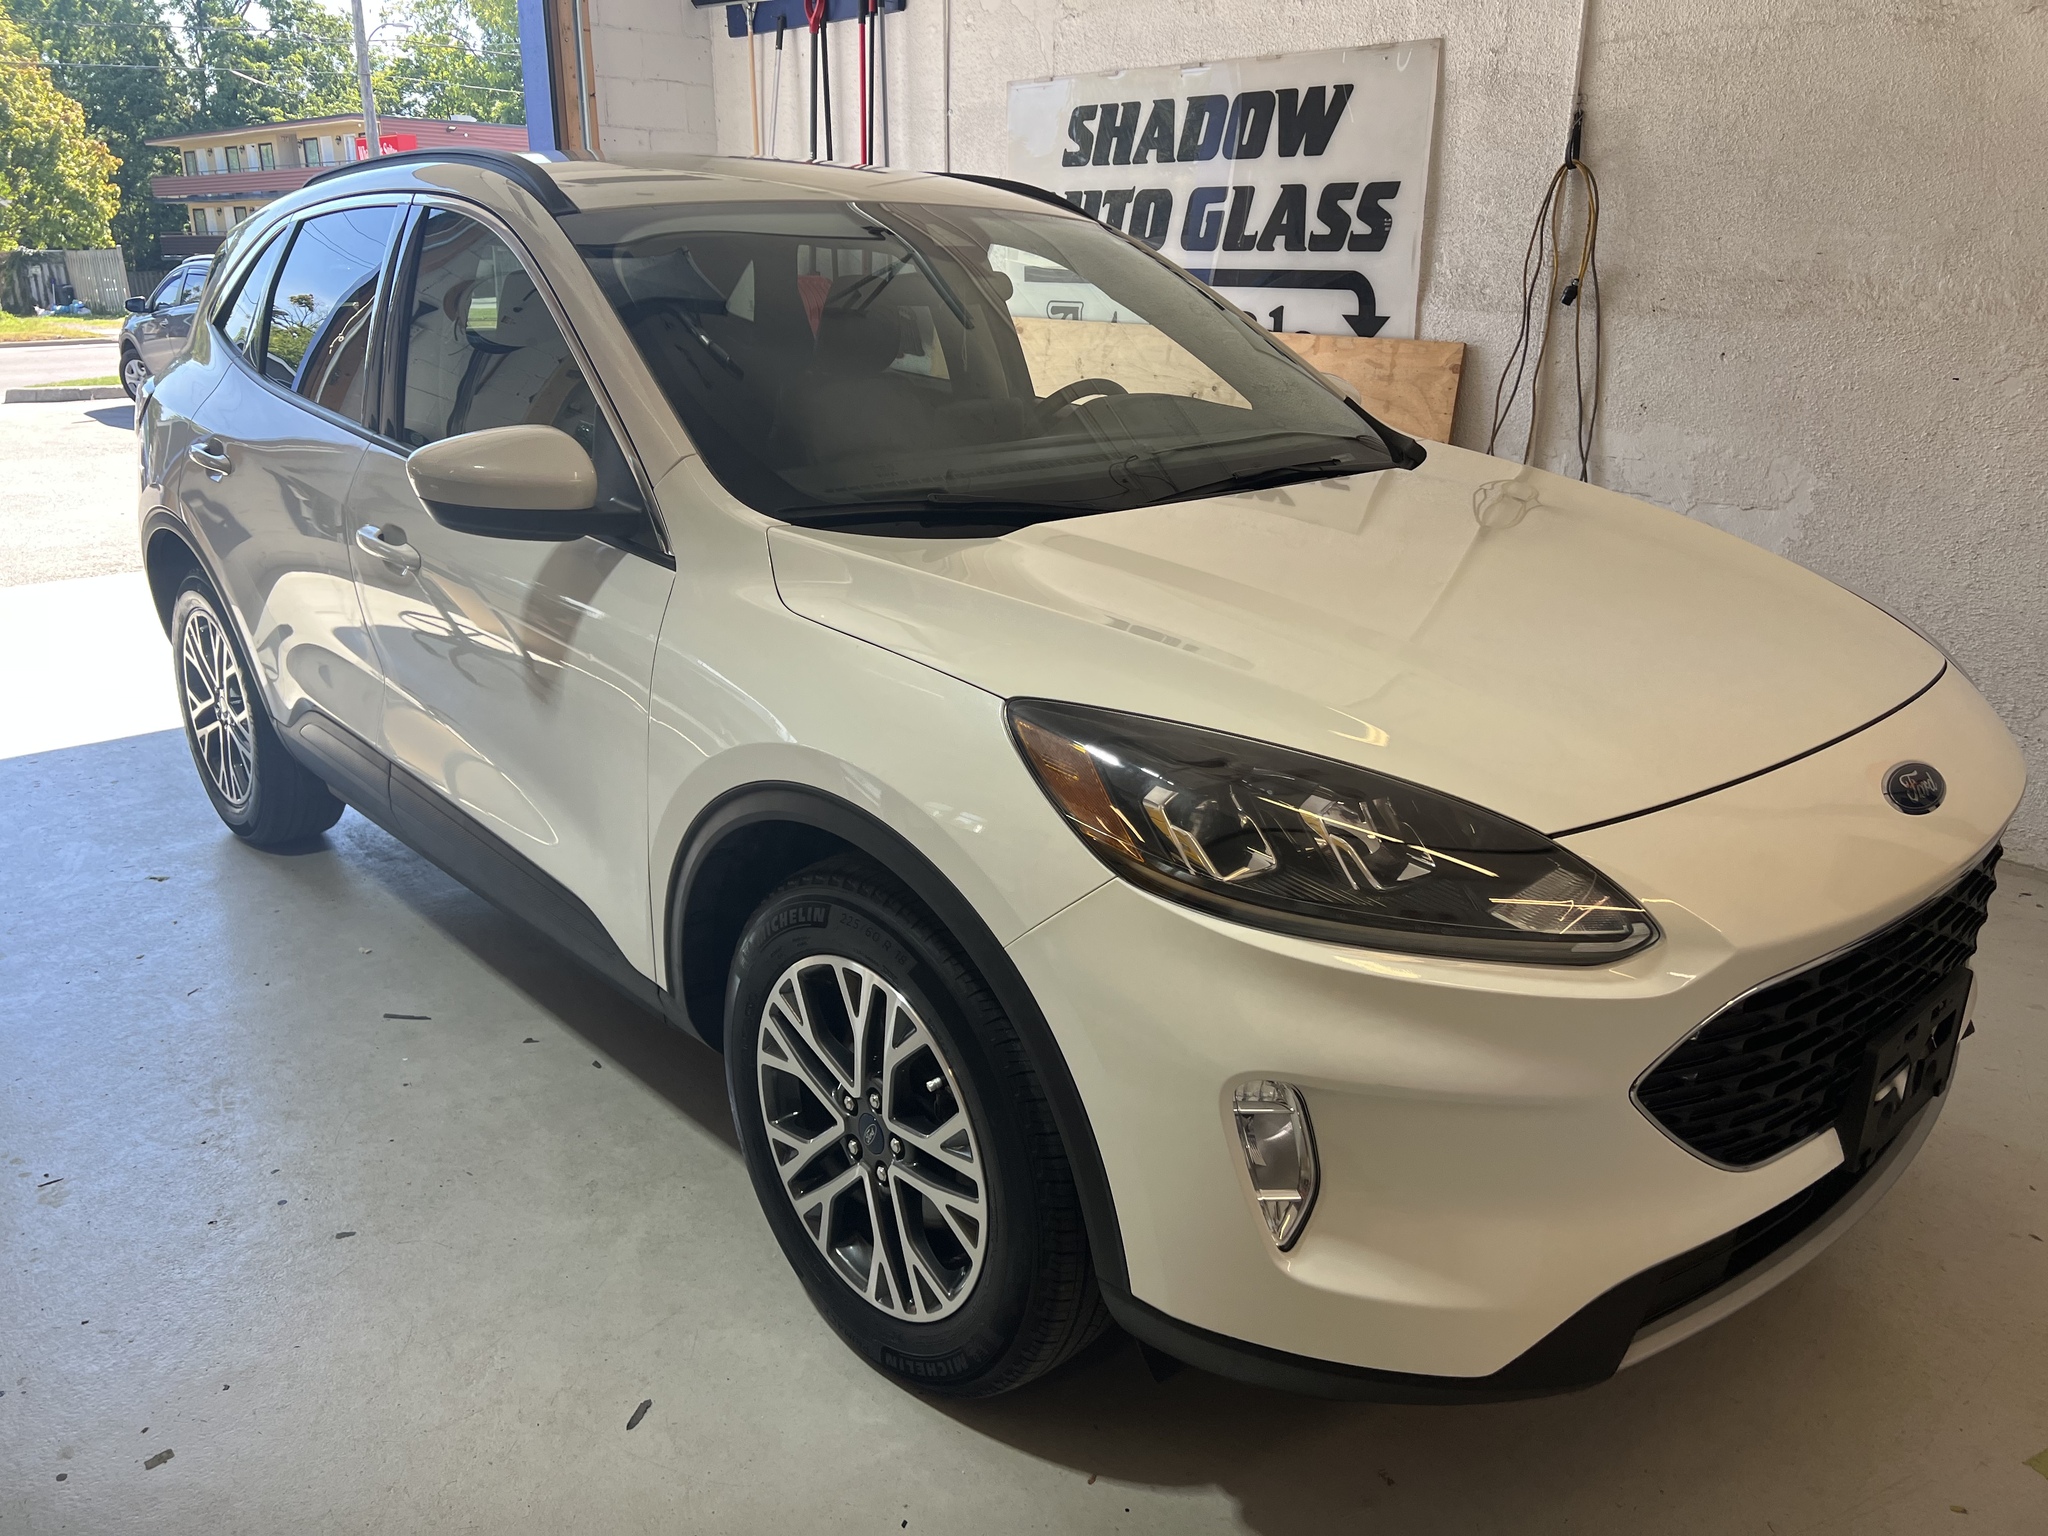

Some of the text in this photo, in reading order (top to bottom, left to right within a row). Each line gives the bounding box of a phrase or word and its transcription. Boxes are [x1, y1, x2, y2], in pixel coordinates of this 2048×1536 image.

[1062, 83, 1354, 167] SHADOW
[1051, 181, 1401, 252] TO GLASS
[1899, 769, 1938, 802] Ford
[885, 1352, 969, 1377] MICHELIN
